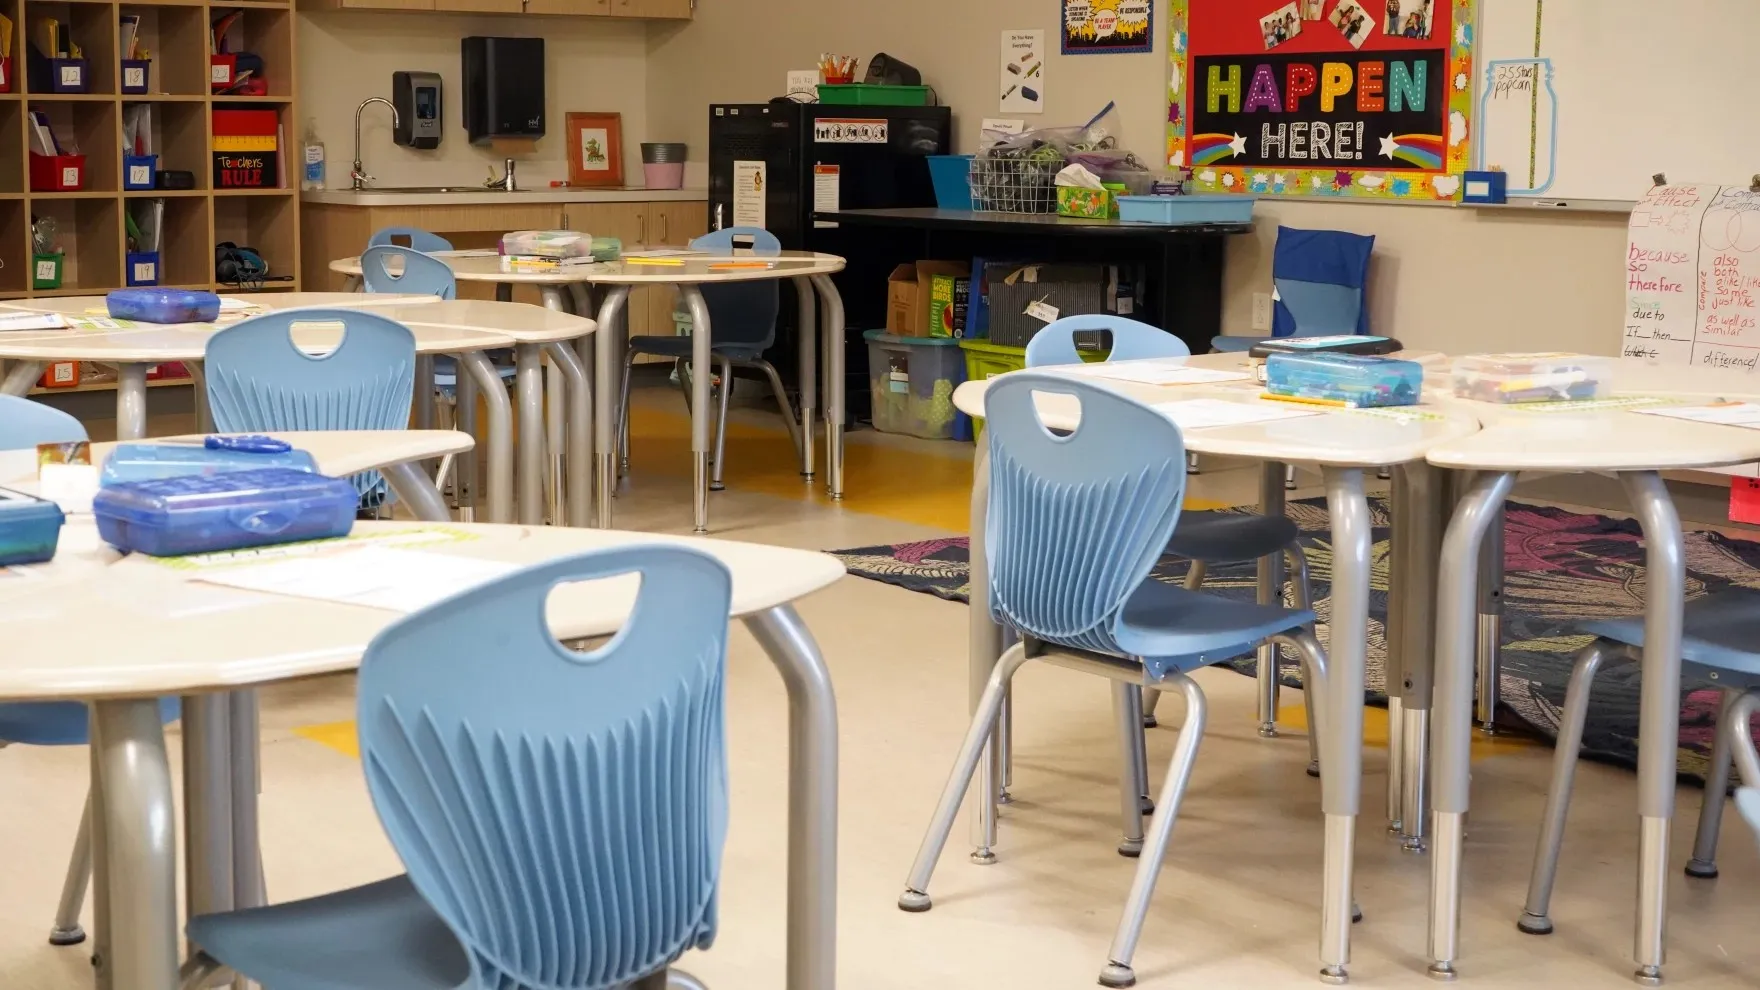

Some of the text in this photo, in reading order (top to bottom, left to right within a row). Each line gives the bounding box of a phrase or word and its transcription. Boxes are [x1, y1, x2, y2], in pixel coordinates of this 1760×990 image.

[129, 70, 141, 83] 18
[1207, 60, 1427, 113] HAPPEN
[1261, 121, 1364, 160] HERE!
[222, 169, 261, 185] RULE
[1646, 184, 1696, 196] Cause
[1628, 242, 1690, 264] because
[1713, 254, 1739, 266] also
[140, 265, 150, 279] 19
[1714, 267, 1739, 277] both
[933, 283, 952, 292] MORE
[1629, 274, 1683, 293] therefore
[933, 290, 951, 302] BIRDS
[1633, 308, 1665, 320] due to
[1707, 314, 1755, 328] as well as
